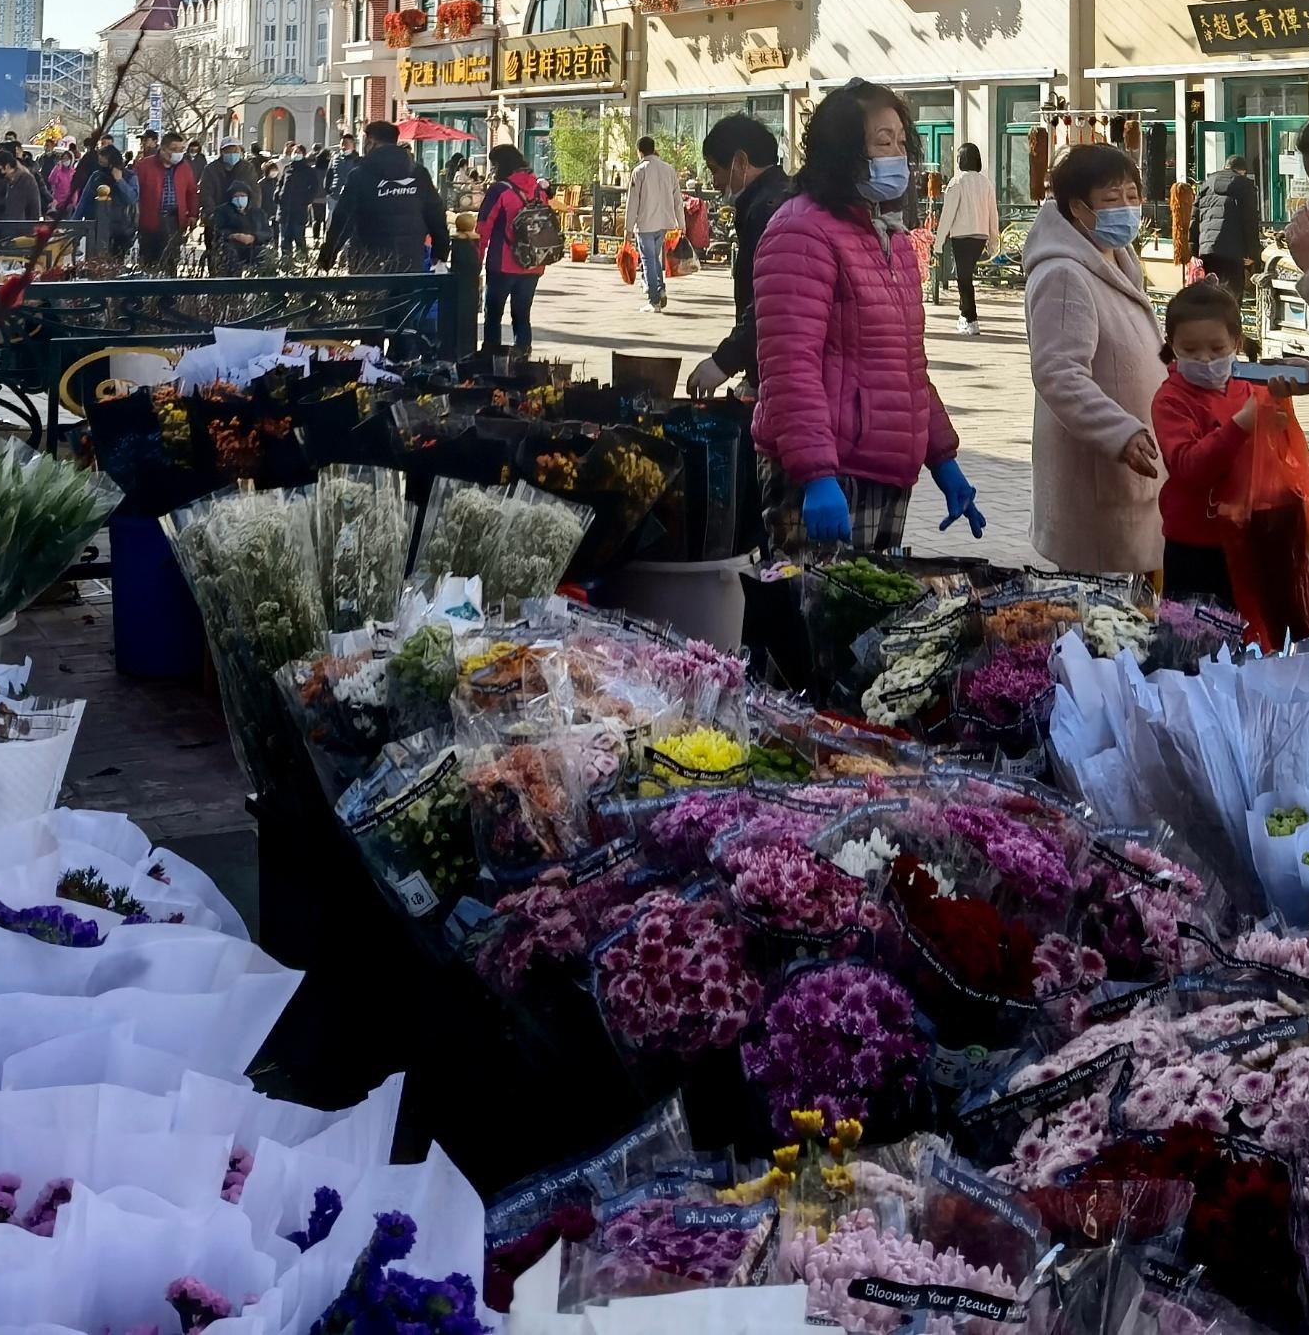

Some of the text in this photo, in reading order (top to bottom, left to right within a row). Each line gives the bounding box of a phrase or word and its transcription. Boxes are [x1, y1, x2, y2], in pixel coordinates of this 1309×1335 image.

[521, 42, 608, 81] 华祥苑茗茶
[377, 186, 418, 197] LI-NING
[1038, 1080, 1069, 1099] Beauty
[1069, 1067, 1093, 1083] Hifun
[1094, 1054, 1113, 1070] Your
[865, 1282, 920, 1307] Blooming
[927, 1290, 954, 1307] Your
[956, 1295, 1002, 1320] Beauty
